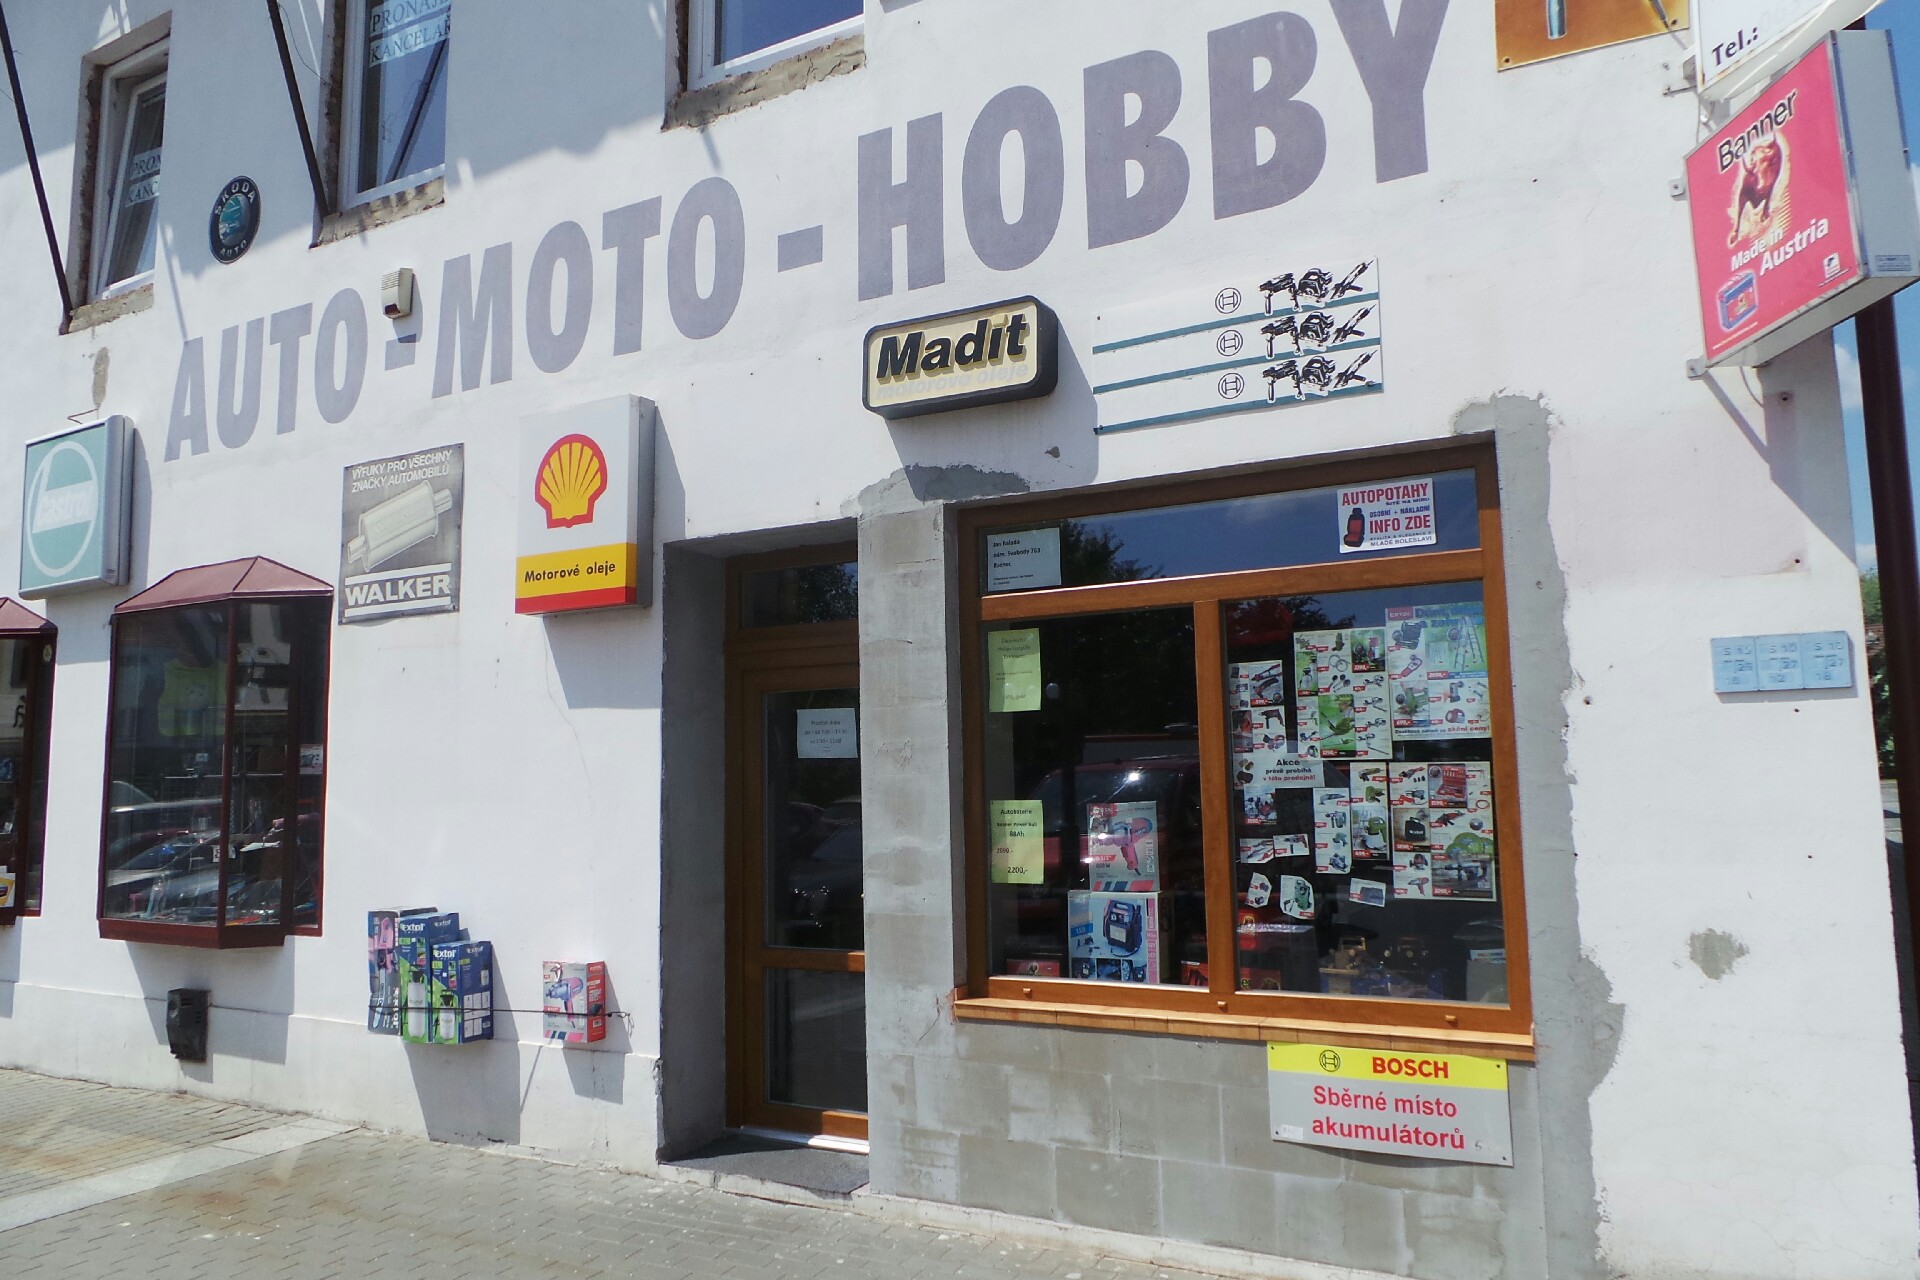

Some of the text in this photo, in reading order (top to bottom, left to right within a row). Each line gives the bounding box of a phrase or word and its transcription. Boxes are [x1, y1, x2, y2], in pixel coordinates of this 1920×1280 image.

[1712, 27, 1758, 66] Tel.:
[1719, 90, 1797, 172] Banner
[164, 288, 368, 462] AUTO
[432, 177, 745, 399] MOTO
[858, 0, 1450, 301] HOBBY
[1759, 218, 1829, 276] Austria
[220, 240, 248, 257] AUTO
[1731, 226, 1784, 271] Made in
[876, 313, 1029, 380] Madit
[352, 450, 452, 479] VÝFUKY PRO VŠECHNY
[352, 462, 449, 493] ZNAČKY AUTOMOBILŮ
[1342, 483, 1428, 506] AUTOPOTAHY
[1369, 515, 1431, 534] INFO ZDE
[524, 560, 616, 583] Motorové oleje
[345, 574, 451, 606] WALKER
[1007, 866, 1028, 875] 2200,-
[1372, 1056, 1449, 1079] BOSCH
[1313, 1085, 1458, 1118] Sběrné místo
[1312, 1116, 1465, 1150] akumulátorů
